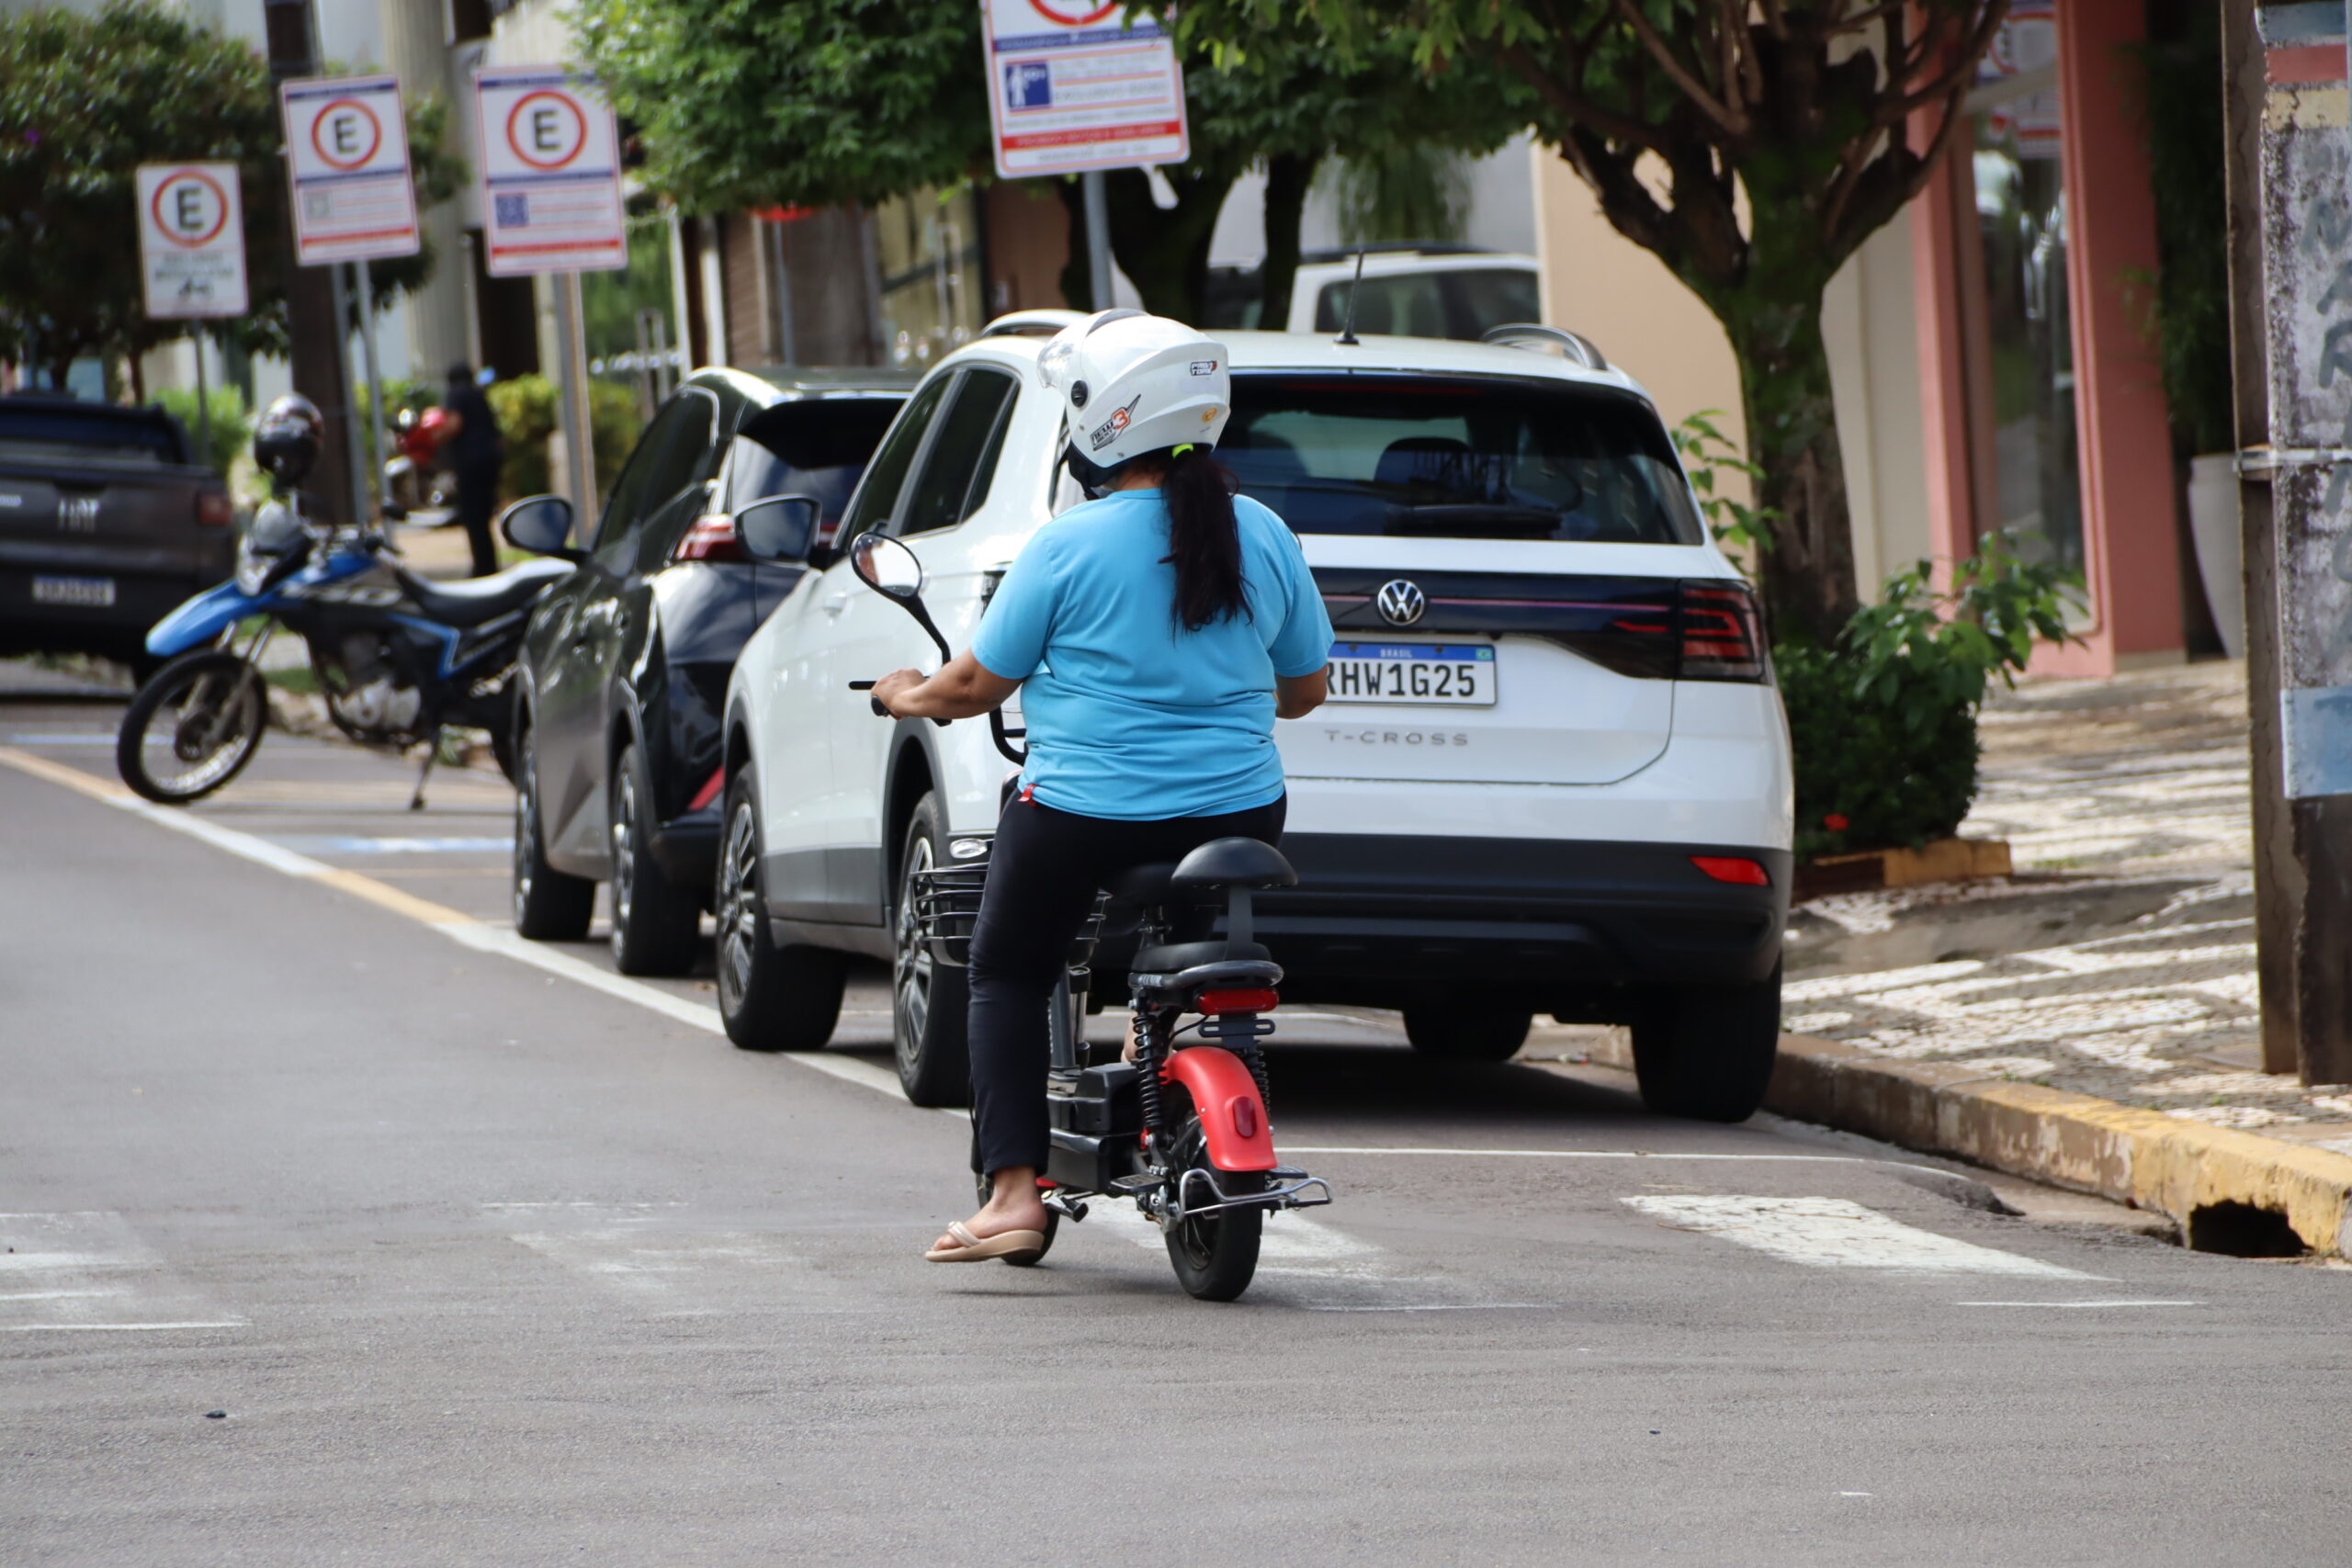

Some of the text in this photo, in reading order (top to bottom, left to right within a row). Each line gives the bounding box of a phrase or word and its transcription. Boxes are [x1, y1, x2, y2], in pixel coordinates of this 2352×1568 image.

[334, 116, 359, 154] E
[533, 110, 561, 152] E
[177, 187, 204, 231] E
[1112, 409, 1129, 431] 3
[1380, 648, 1413, 659] BRASIL
[1324, 728, 1469, 747] T-CROSS
